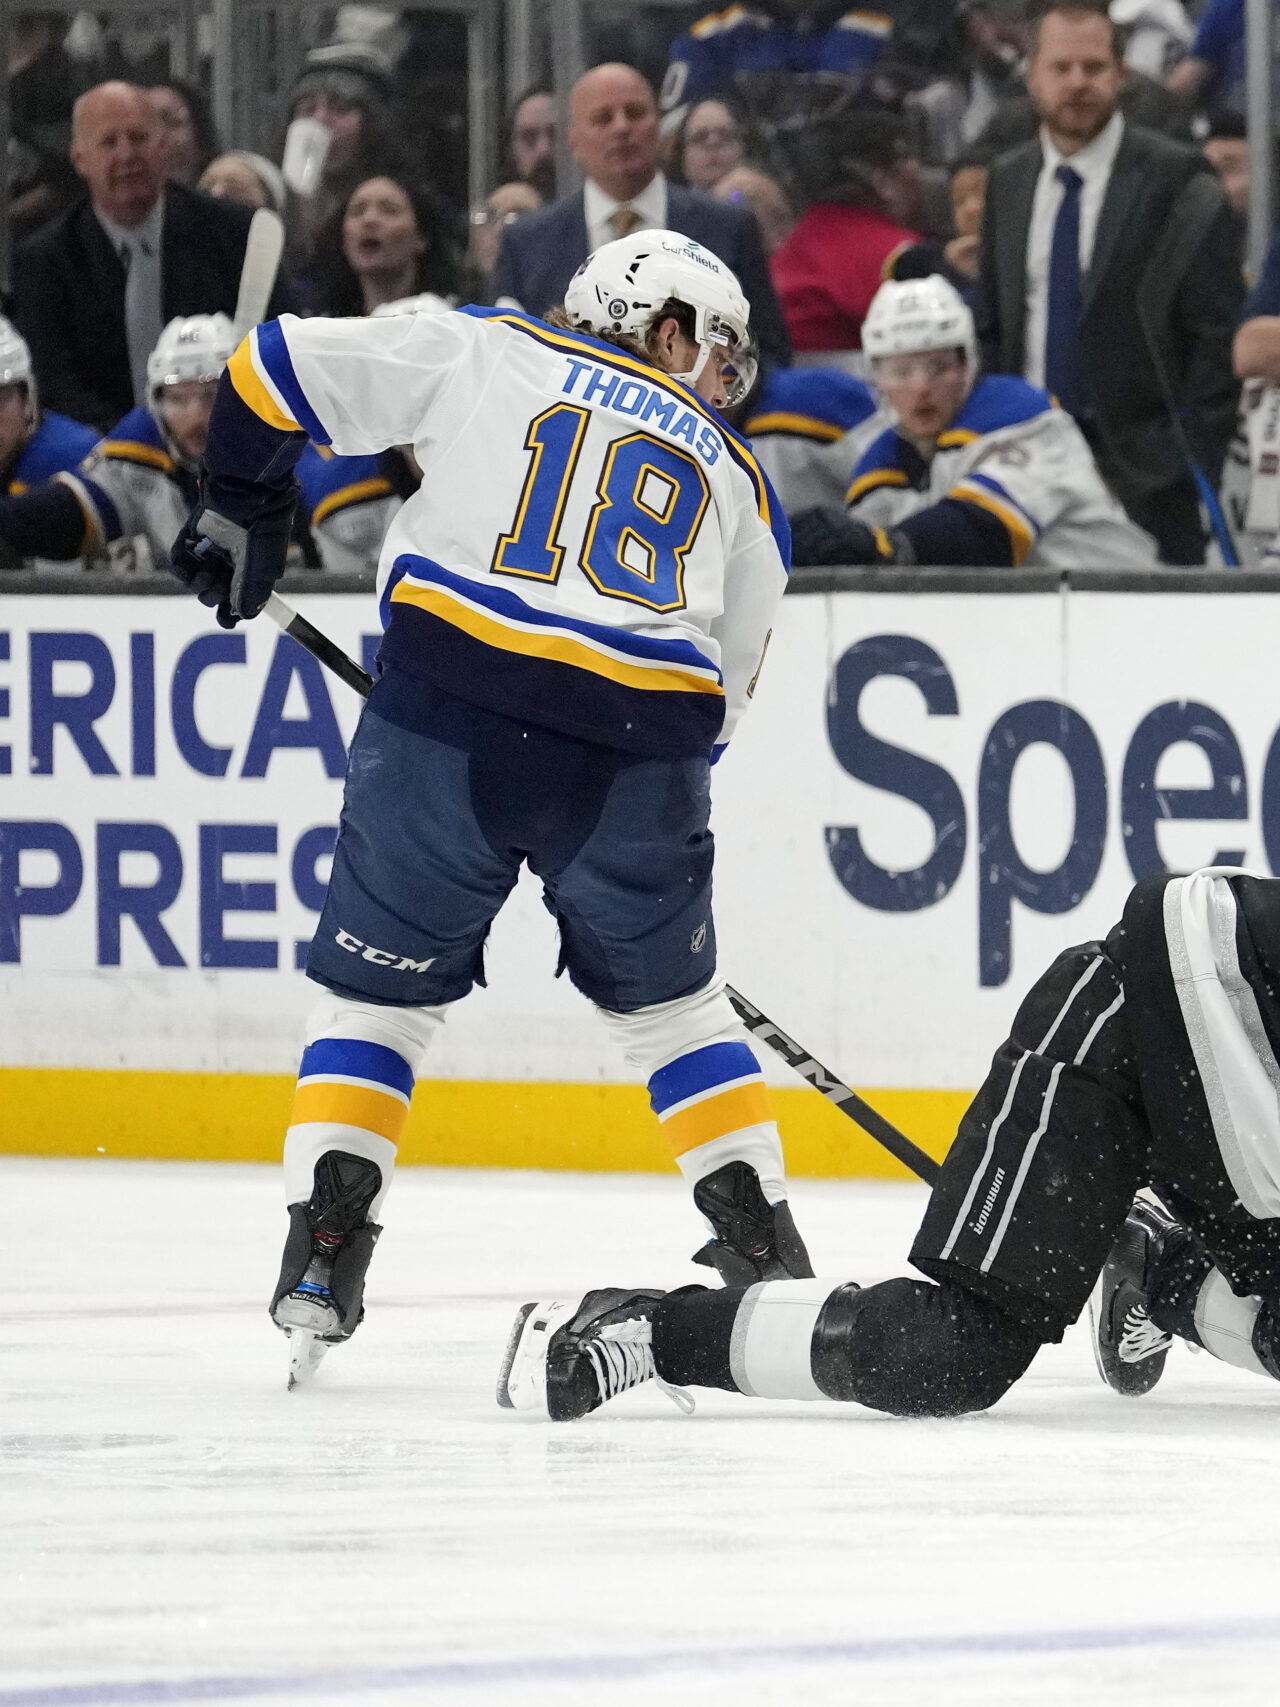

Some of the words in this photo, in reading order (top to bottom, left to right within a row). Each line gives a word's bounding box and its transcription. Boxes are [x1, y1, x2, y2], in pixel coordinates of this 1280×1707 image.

[661, 241, 720, 274] CarShield
[561, 357, 723, 467] THOMAS
[489, 400, 712, 615] 18
[0, 631, 382, 779] RICA
[334, 926, 438, 974] CCM
[973, 1166, 1006, 1236] WARRIOR
